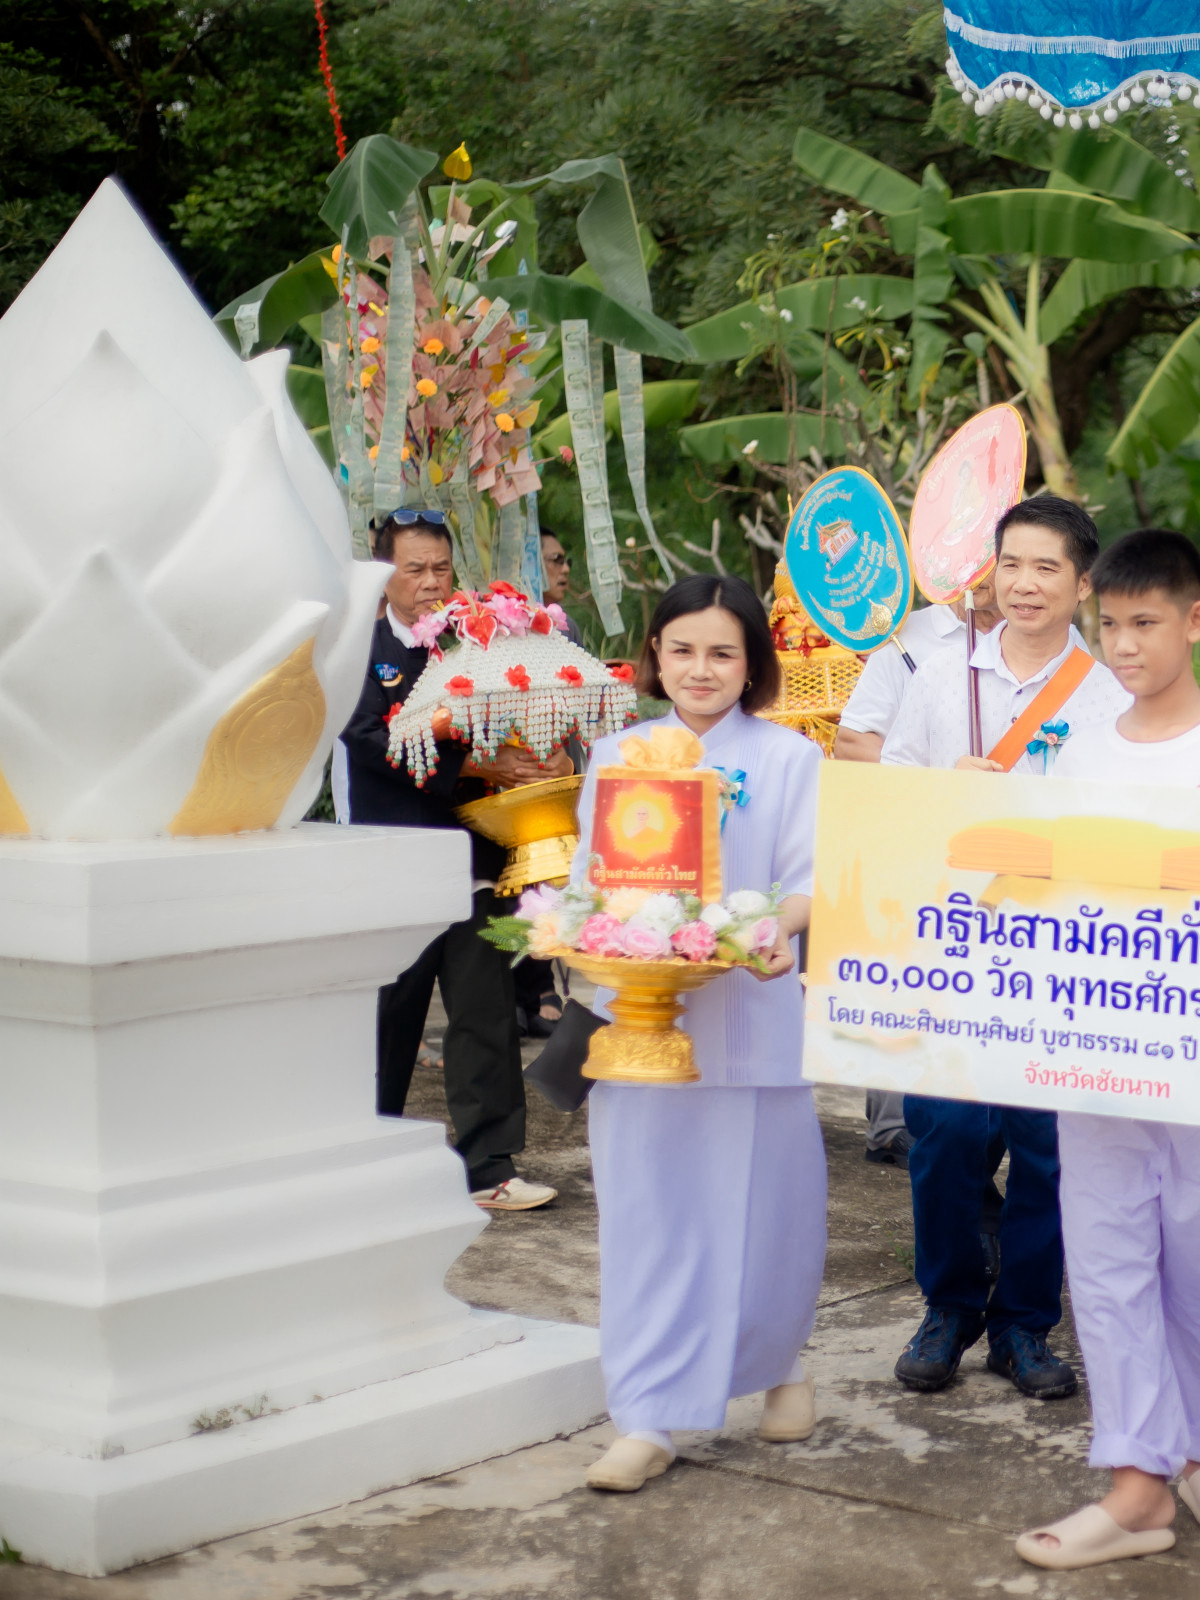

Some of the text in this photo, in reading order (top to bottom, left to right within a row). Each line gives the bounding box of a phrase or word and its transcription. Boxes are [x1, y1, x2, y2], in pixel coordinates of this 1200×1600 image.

[838, 957, 975, 995] ๓๐,๐๐๐
[986, 954, 1034, 1001] วัด
[827, 995, 866, 1026] โดย
[870, 1008, 1036, 1049] คณะศิษยานุศิษย์
[1040, 1029, 1139, 1055] บูชาธรรม
[1144, 1041, 1176, 1060] ๘๑
[1179, 1035, 1199, 1062] ปี
[1024, 1060, 1172, 1099] จังหวัดชัยนาท
